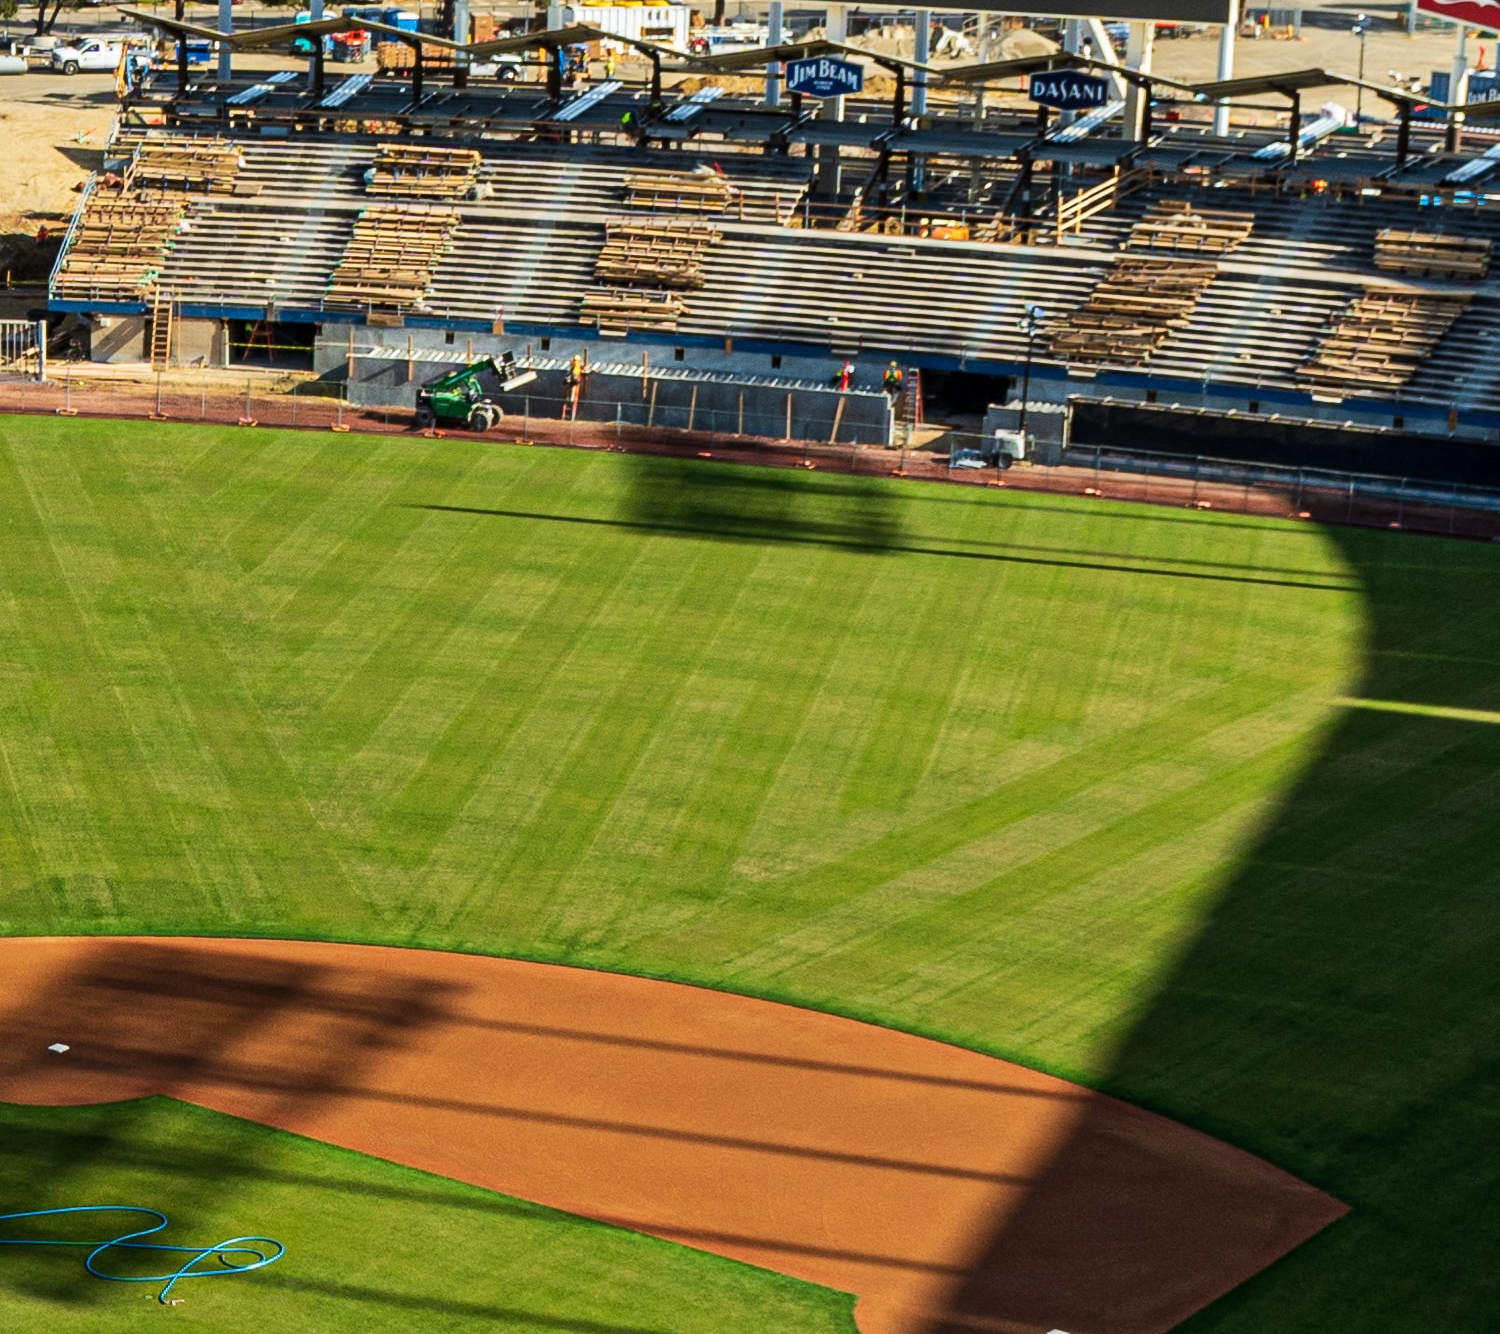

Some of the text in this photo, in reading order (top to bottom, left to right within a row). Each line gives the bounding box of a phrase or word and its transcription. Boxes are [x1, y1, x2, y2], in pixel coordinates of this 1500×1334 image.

[788, 63, 817, 89] JIM
[819, 59, 858, 91] BEAM
[1033, 78, 1103, 102] DASANI
